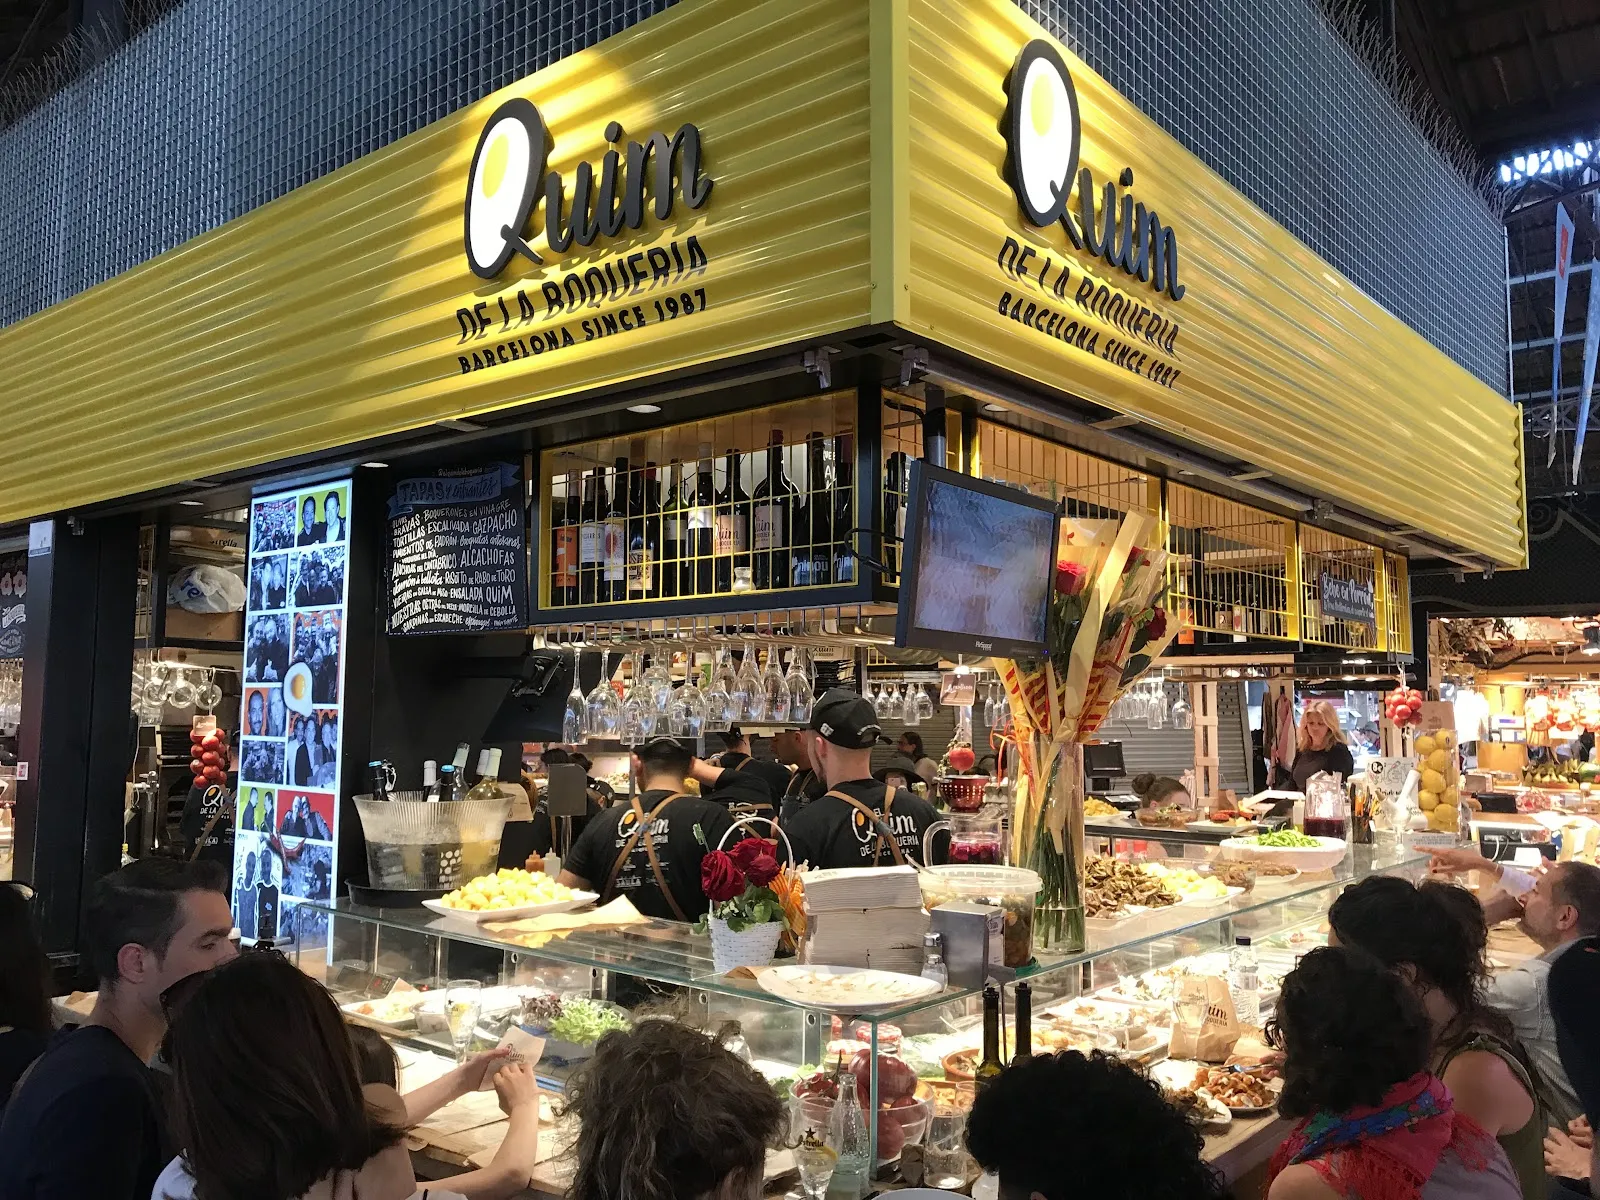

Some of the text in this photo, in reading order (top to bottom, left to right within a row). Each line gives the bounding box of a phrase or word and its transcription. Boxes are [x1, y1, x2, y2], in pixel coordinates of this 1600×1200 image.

[1009, 39, 1185, 301] Quim
[464, 98, 714, 279] Quim
[457, 236, 708, 343] DE LA BOQUERIA
[998, 237, 1180, 355] DE LA BOQUERIA
[458, 288, 707, 374] BARCELONA SINCE 1987
[998, 292, 1099, 354] BARCELONA
[1102, 338, 1147, 376] SINCE
[399, 482, 444, 502] TAPAS
[393, 509, 517, 547] TORTILLAS ESCALIVADA GAZPACHO
[394, 498, 511, 536] BRAVAS BOQUERONES EN VINAGRE
[460, 548, 515, 567] ALCACHOFAS
[474, 571, 491, 584] RABO
[497, 569, 516, 583] TORO
[418, 586, 432, 596] SALSA
[450, 587, 483, 602] ENSALADA
[391, 600, 421, 629] NUESTRAS
[490, 605, 516, 617] CEBOLLA
[434, 613, 463, 624] ESCABECHE
[852, 807, 917, 843] Qim
[873, 808, 885, 817] EL
[615, 840, 625, 848] DE
[860, 844, 872, 857] DE
